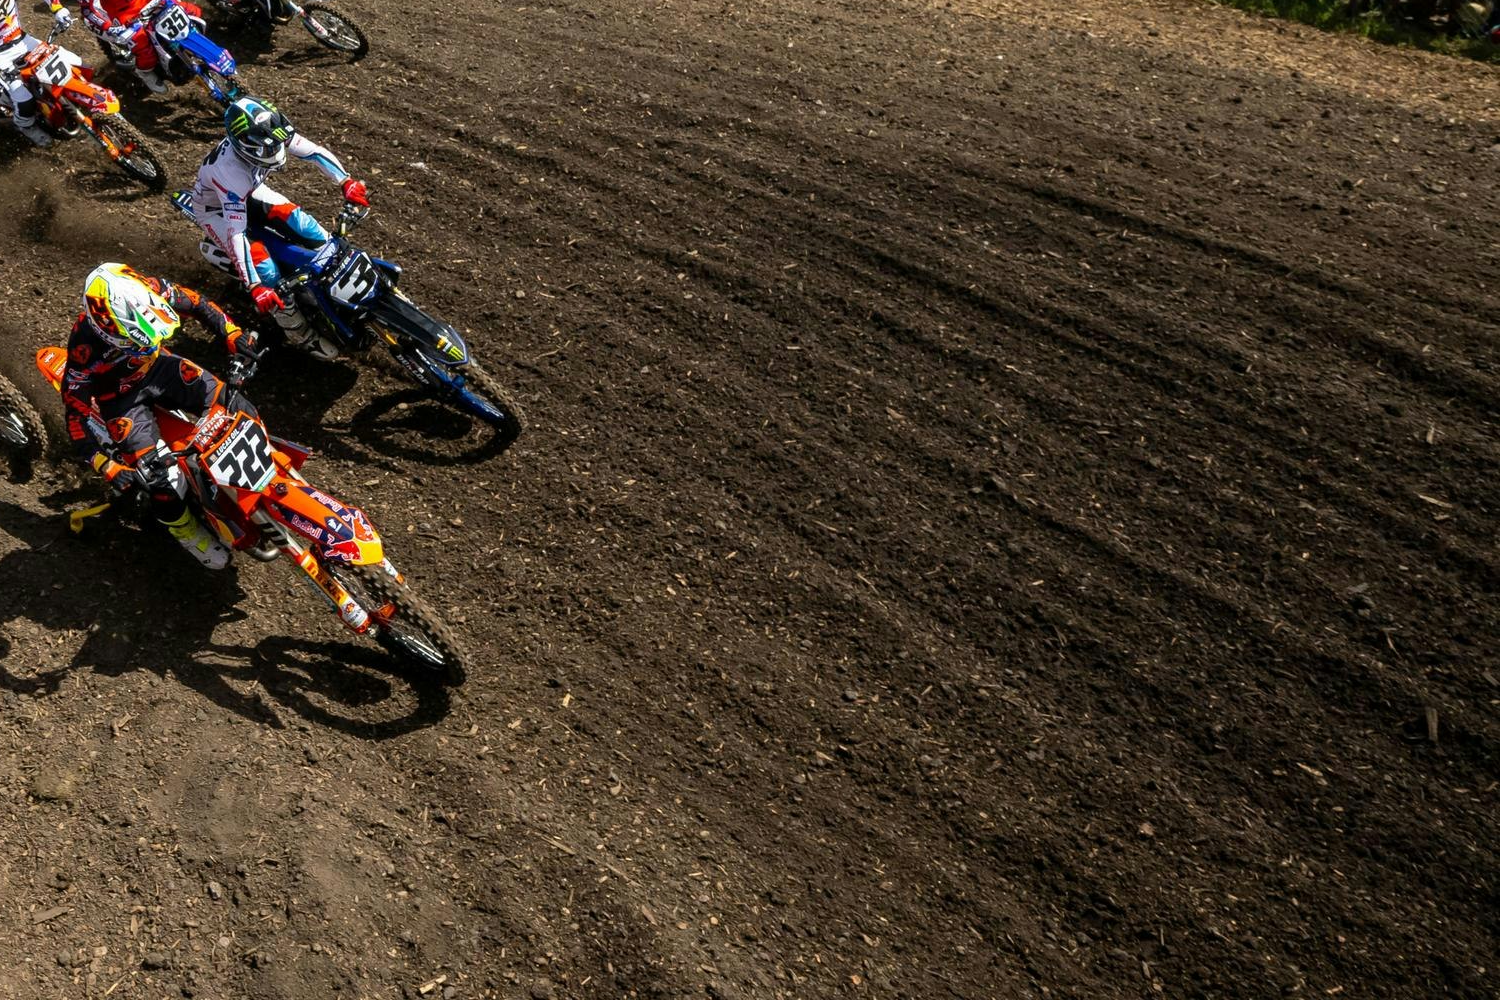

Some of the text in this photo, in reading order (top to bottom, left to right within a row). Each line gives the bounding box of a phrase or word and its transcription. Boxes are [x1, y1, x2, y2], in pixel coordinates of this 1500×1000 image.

[161, 8, 188, 40] 35
[45, 54, 69, 85] 5
[337, 254, 377, 303] 3
[130, 328, 150, 345] Airoh
[216, 429, 240, 456] LUCAS OIL
[218, 420, 272, 490] 222
